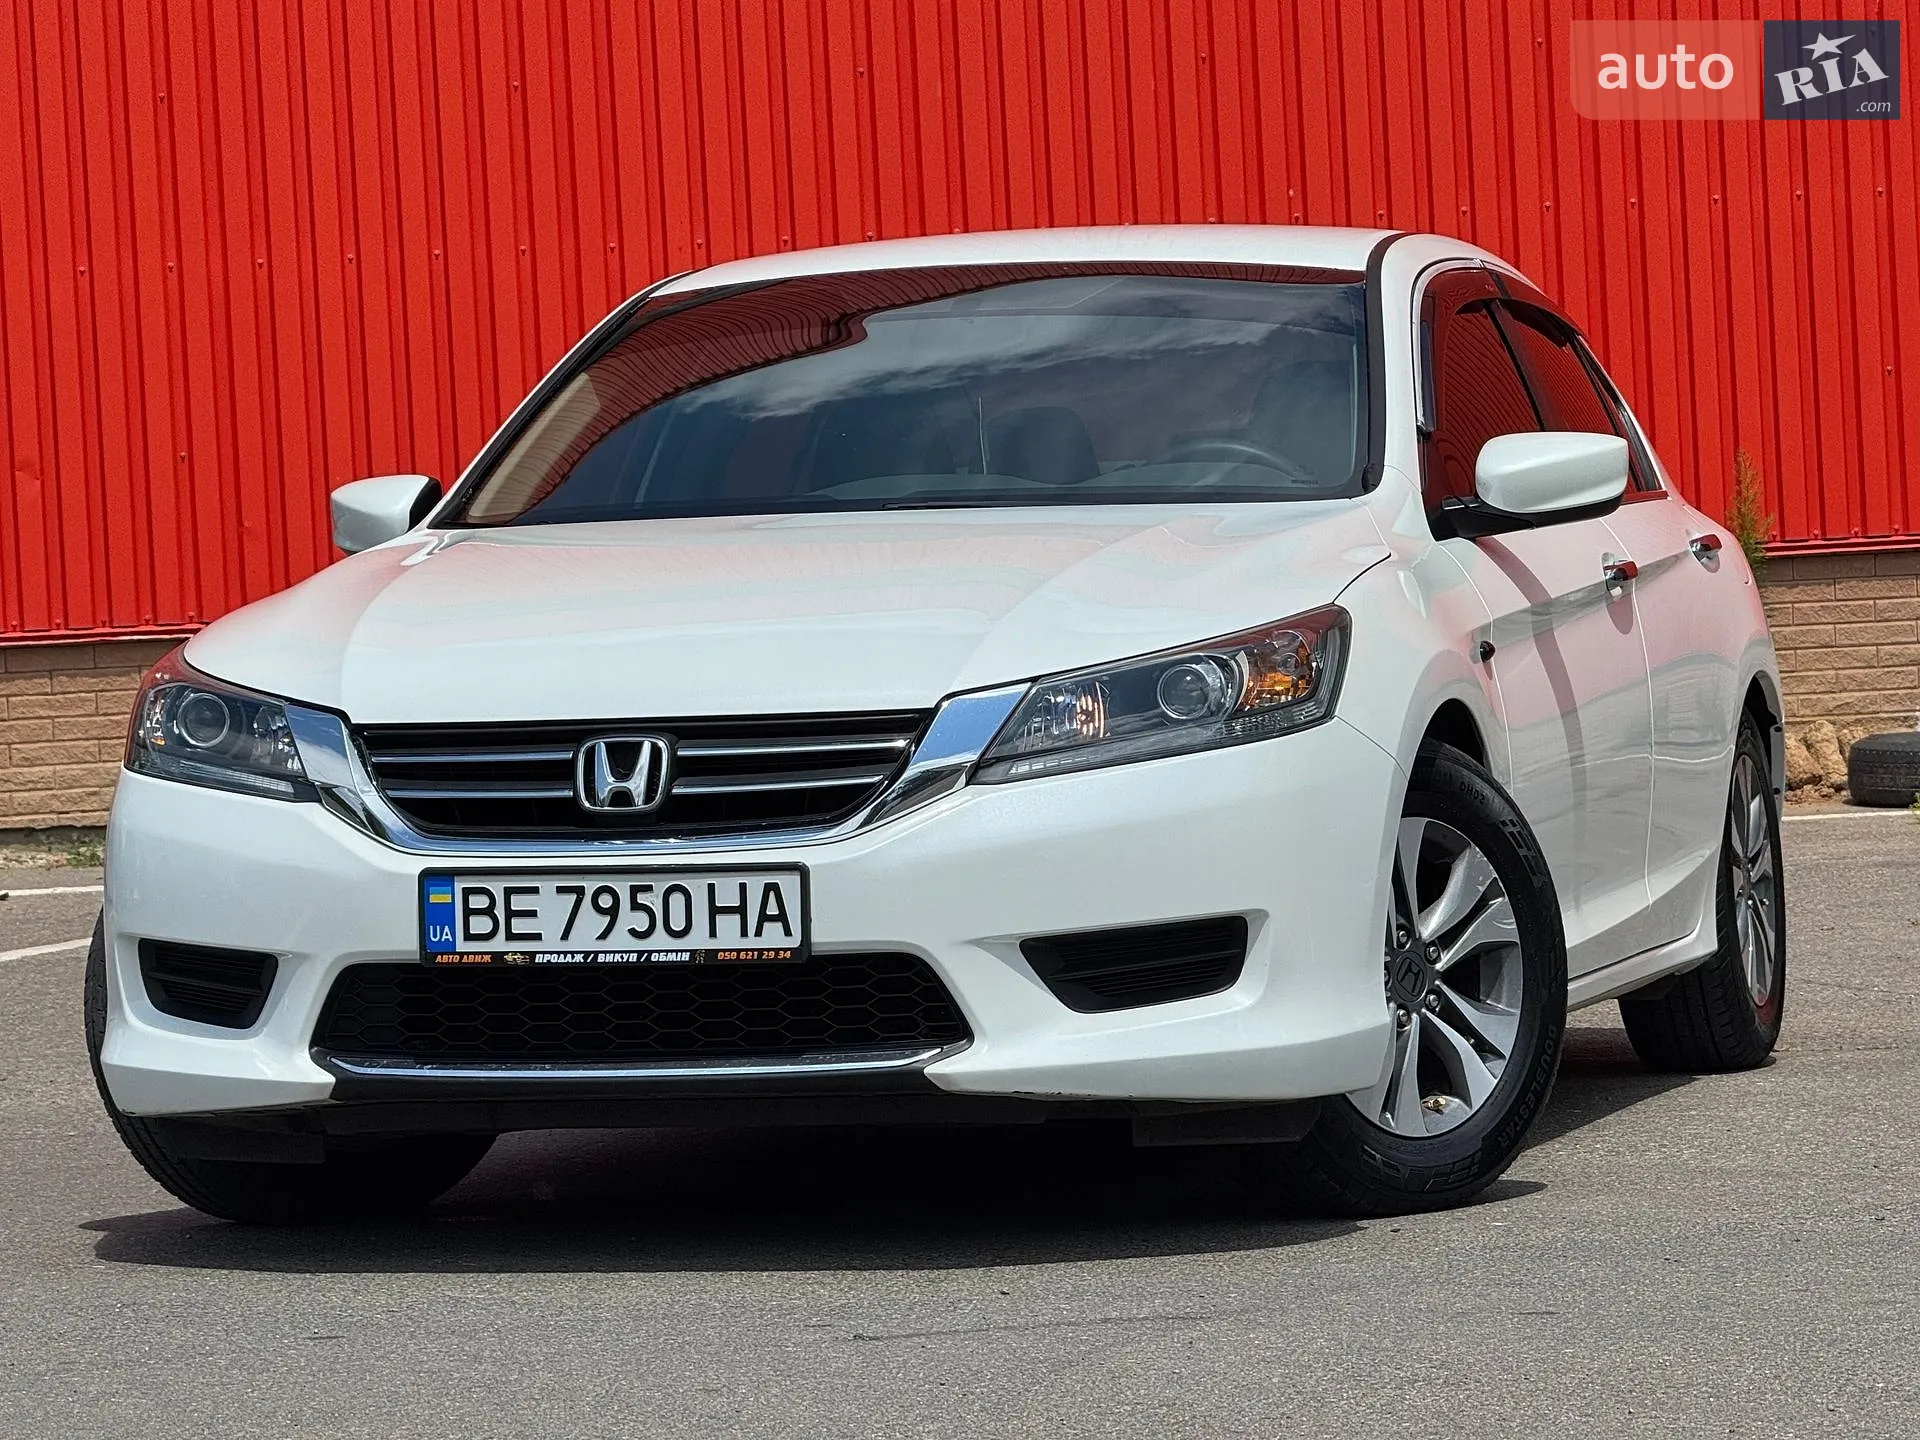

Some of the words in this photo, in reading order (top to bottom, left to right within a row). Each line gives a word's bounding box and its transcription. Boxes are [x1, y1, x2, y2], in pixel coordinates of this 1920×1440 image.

[461, 886, 543, 941] BE
[555, 883, 693, 940] 7950
[706, 881, 793, 938] HA
[429, 925, 453, 942] UA
[435, 954, 460, 963] АВТО
[461, 954, 493, 963] ДВИЖ
[534, 953, 585, 963] ПРОДАЖ
[651, 952, 690, 962] ОБМІН
[717, 951, 737, 960] 050
[739, 951, 758, 960] 621
[762, 950, 775, 959] 29
[777, 950, 792, 959] 34
[1498, 1023, 1557, 1148] DOUBLESTAR
